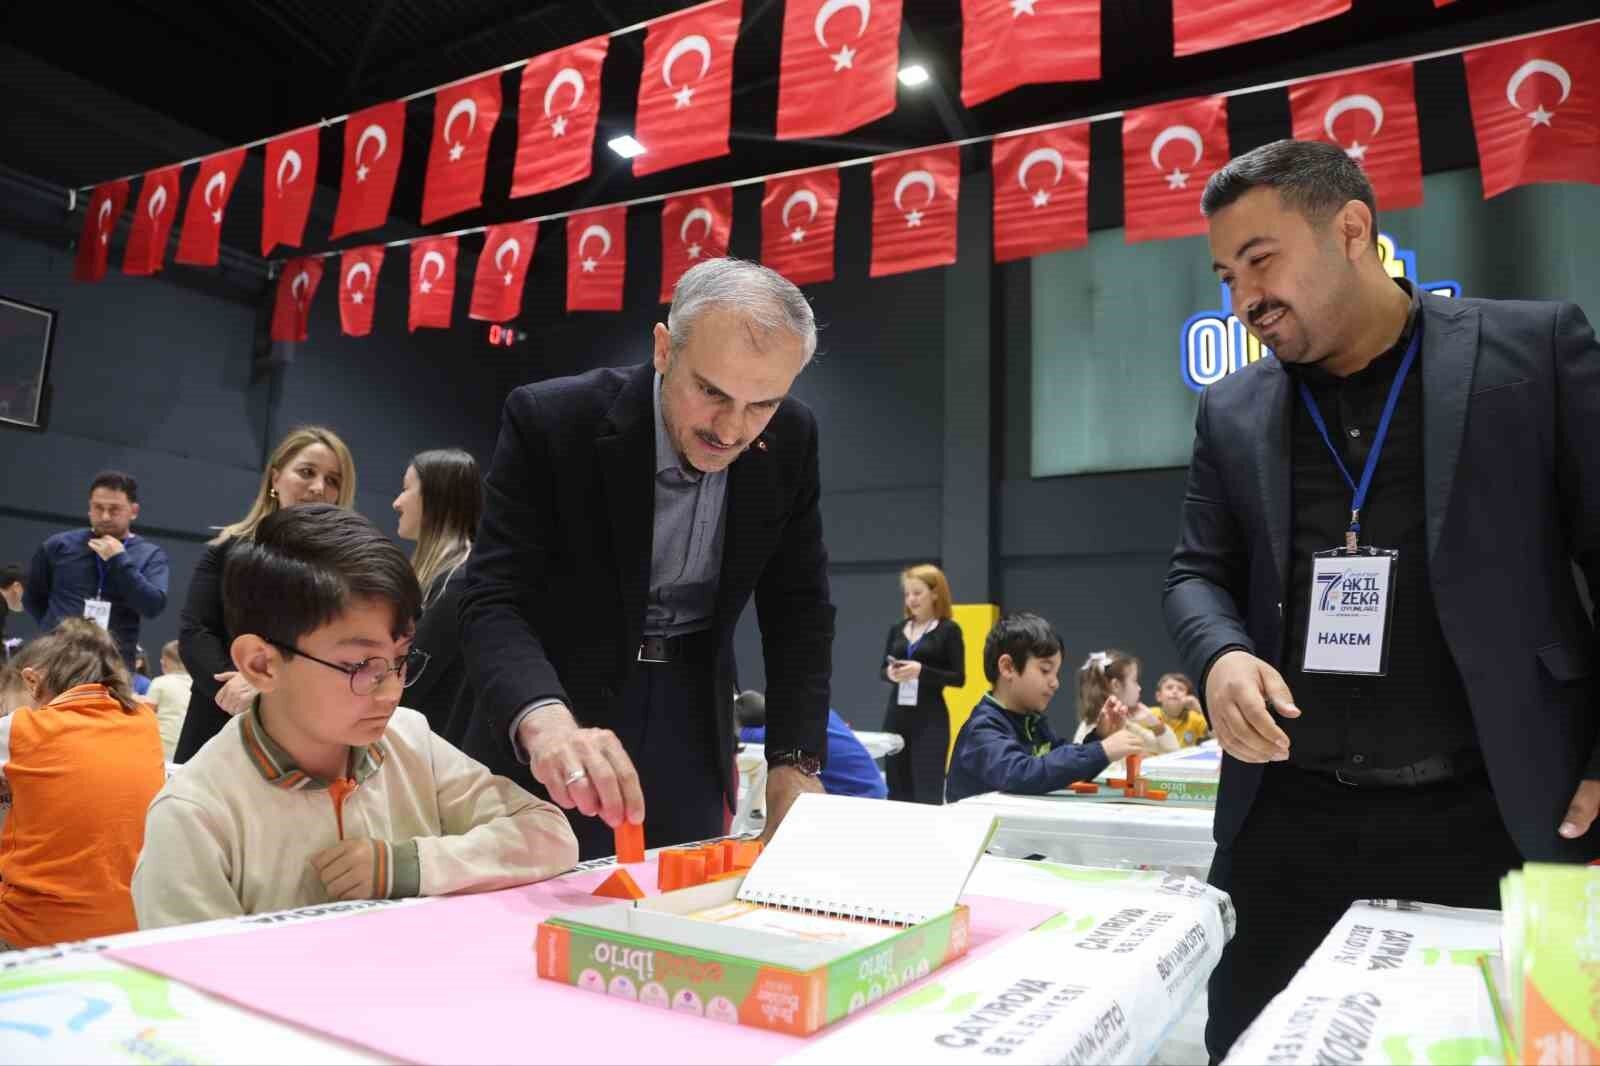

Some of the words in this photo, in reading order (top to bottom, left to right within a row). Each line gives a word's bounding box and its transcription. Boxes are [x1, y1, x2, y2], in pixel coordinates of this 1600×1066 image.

[1342, 577, 1380, 591] AKIL
[1341, 591, 1379, 605] ZEKA
[1318, 632, 1371, 646] HAKEM
